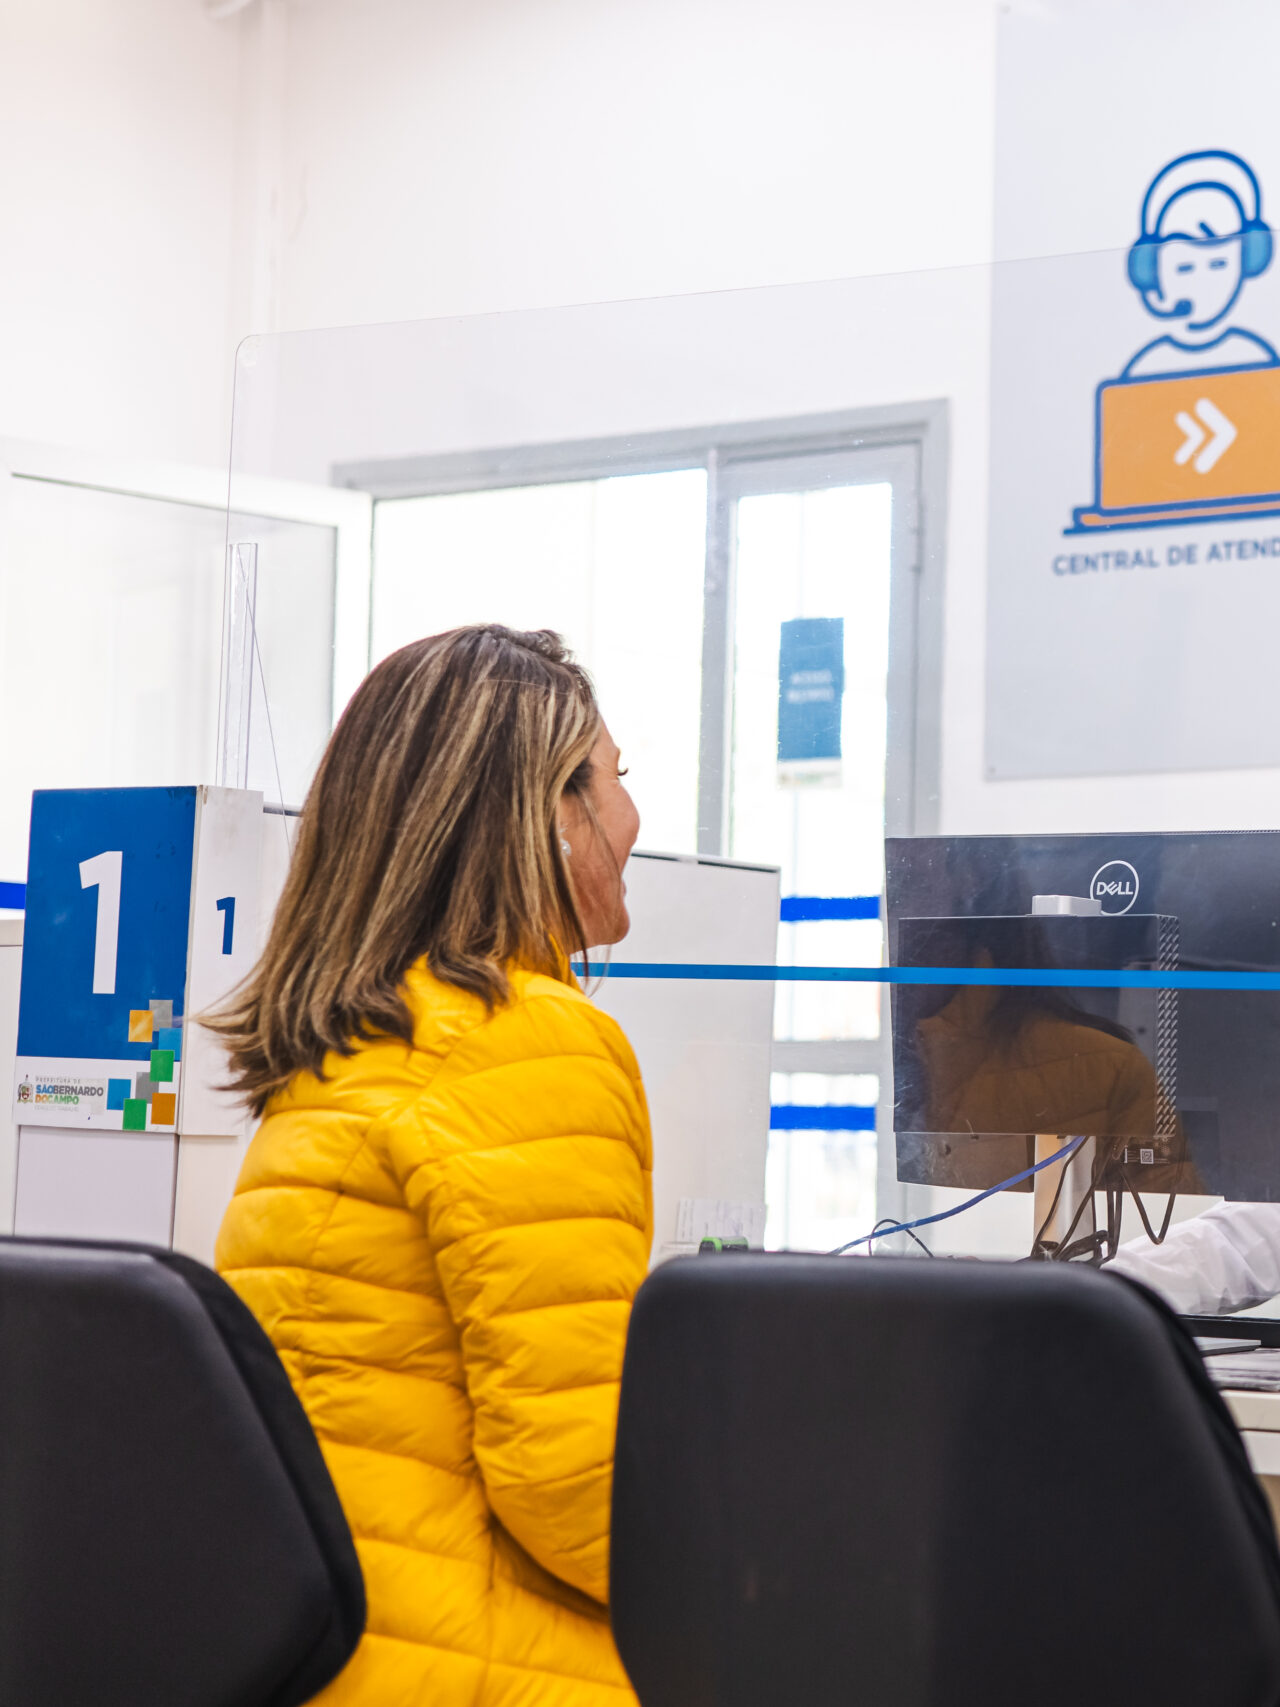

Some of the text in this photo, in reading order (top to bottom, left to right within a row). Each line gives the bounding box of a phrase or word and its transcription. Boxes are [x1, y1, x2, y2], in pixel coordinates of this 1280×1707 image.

[1052, 546, 1160, 577] CENTRAL
[1166, 543, 1199, 567] DE
[1096, 880, 1134, 896] DELL
[79, 850, 123, 995] 1
[216, 896, 236, 955] 1
